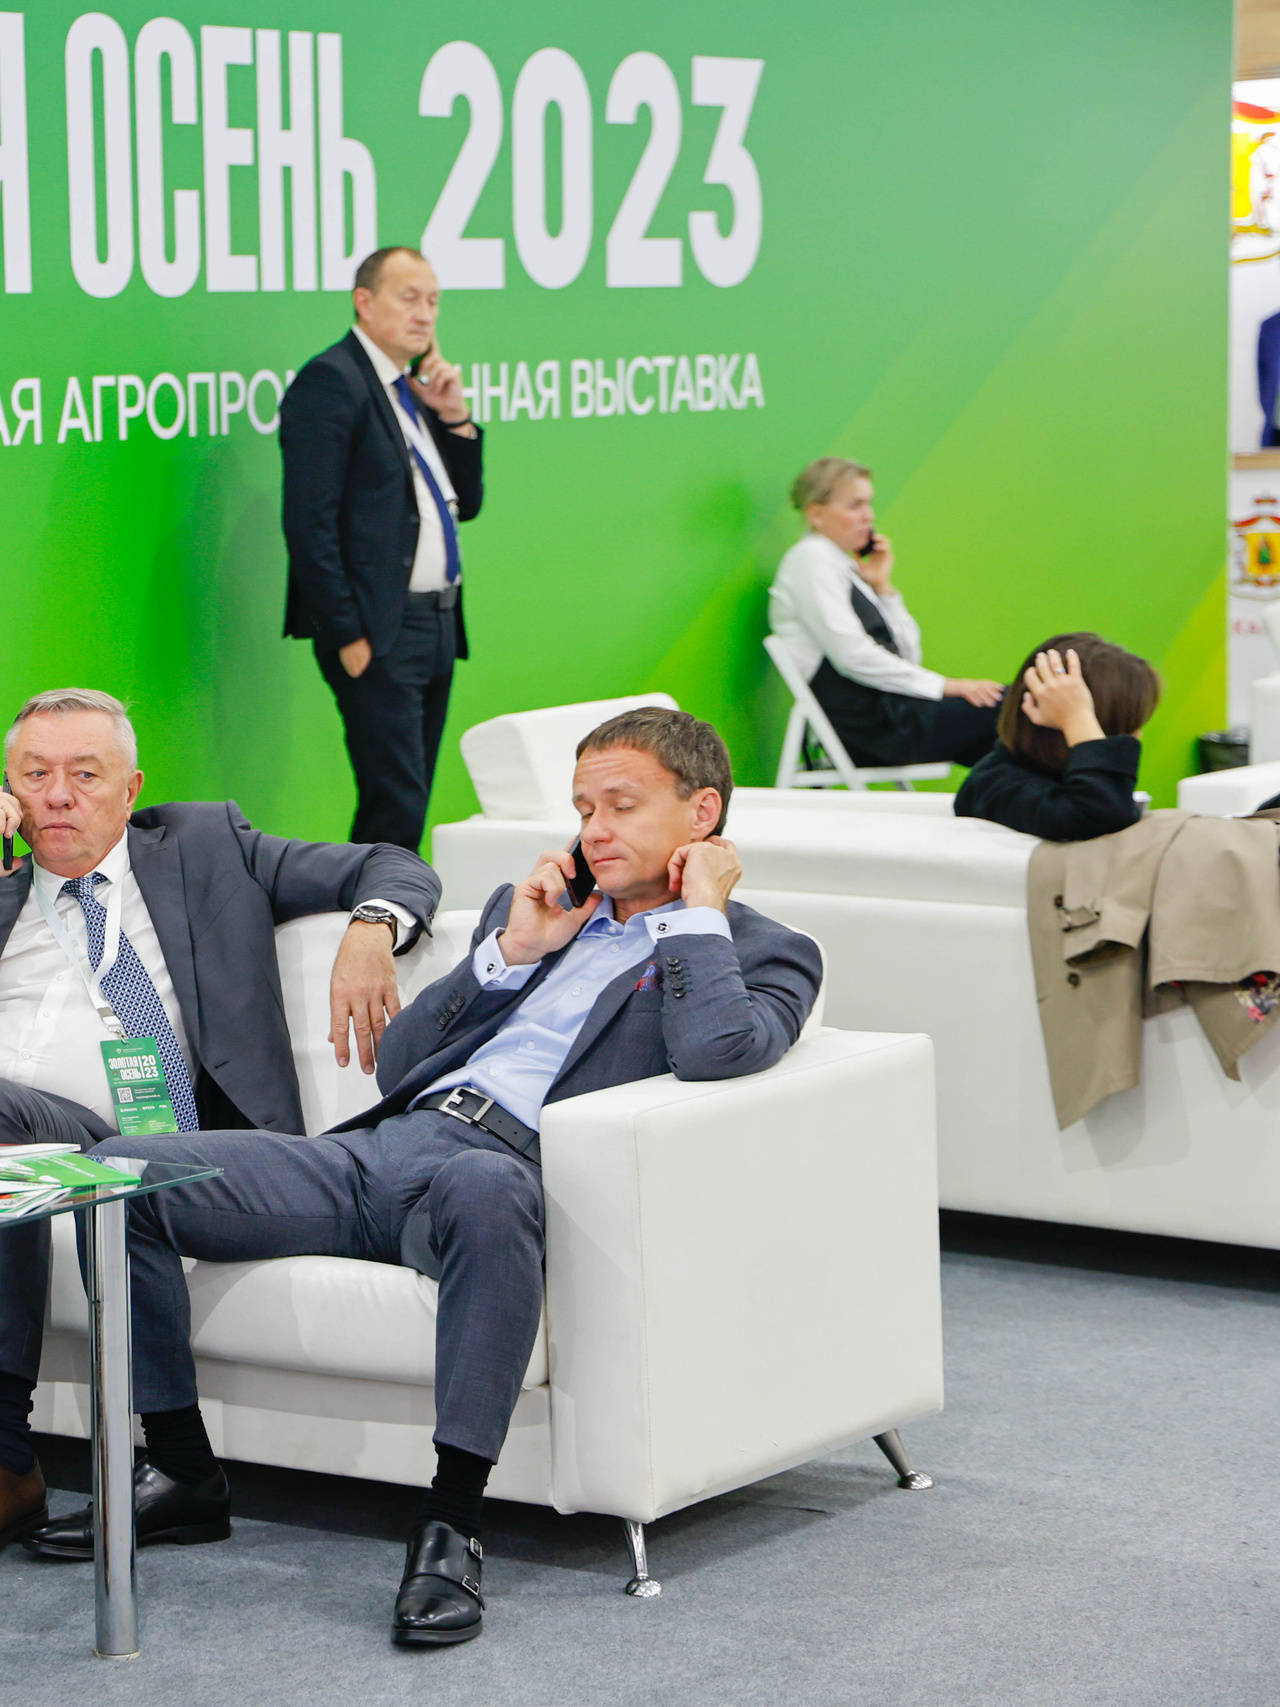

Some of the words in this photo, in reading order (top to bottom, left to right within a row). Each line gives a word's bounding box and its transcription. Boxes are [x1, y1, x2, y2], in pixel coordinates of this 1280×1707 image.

[64, 12, 378, 298] ОСЕНЬ
[418, 40, 766, 289] 2023
[57, 360, 562, 444] АГРОПРОННАЯ
[571, 353, 766, 419] ВЫСТАВКА
[108, 1056, 139, 1069] ЗОЛОТАЯ
[142, 1055, 156, 1066] 20
[120, 1067, 142, 1080] ОСЕНЬ
[144, 1066, 159, 1078] 23
